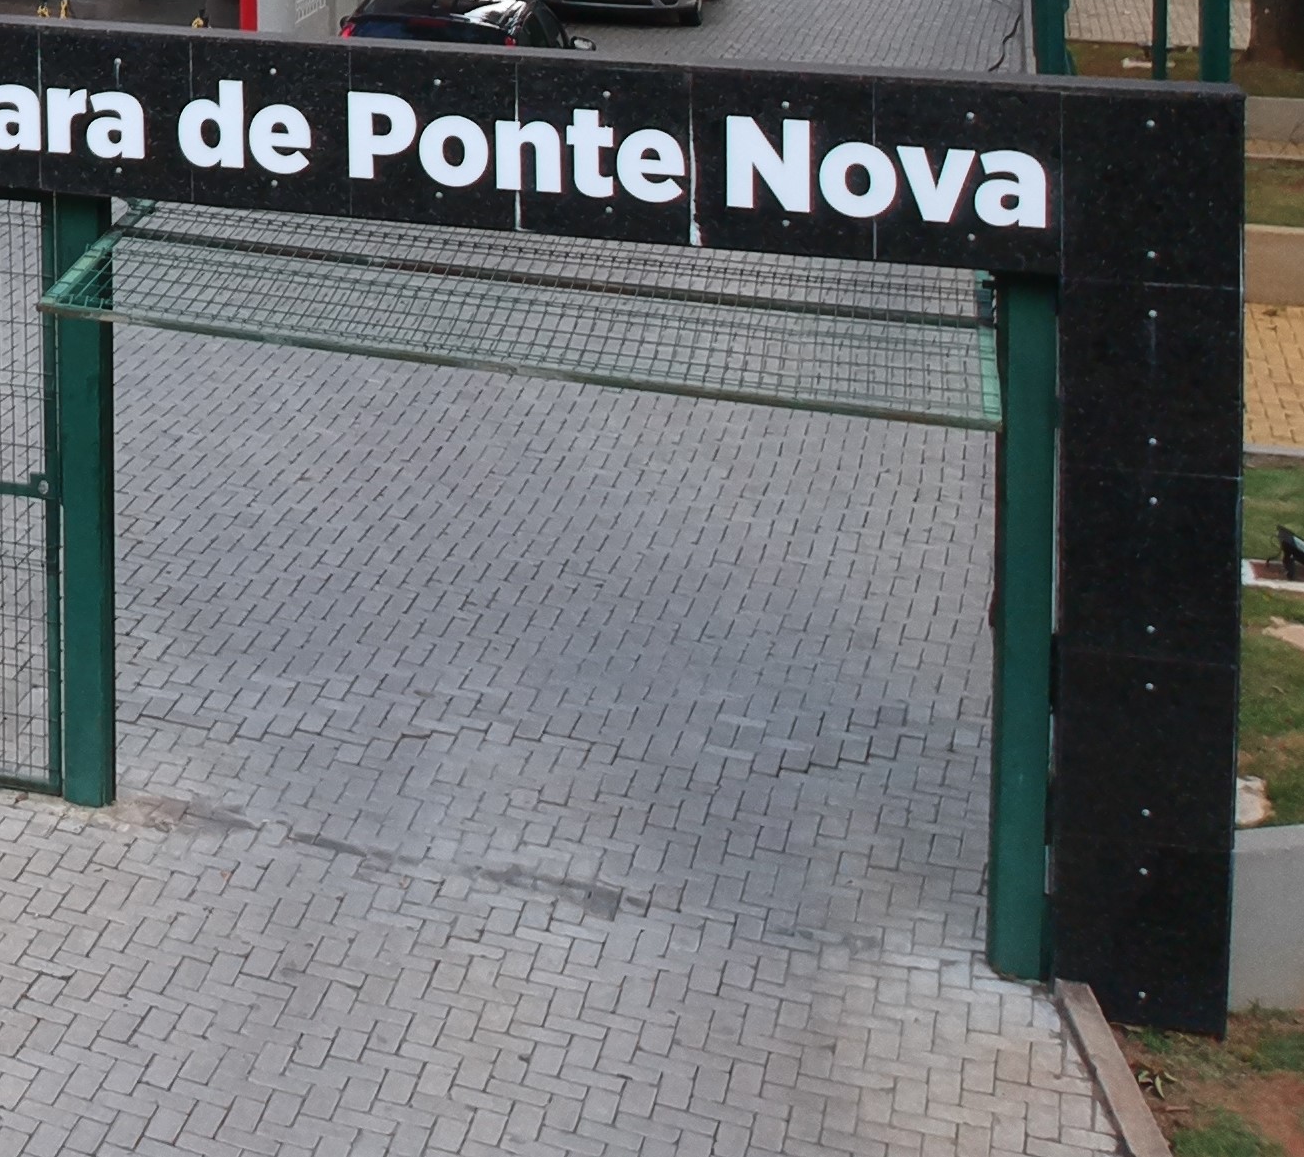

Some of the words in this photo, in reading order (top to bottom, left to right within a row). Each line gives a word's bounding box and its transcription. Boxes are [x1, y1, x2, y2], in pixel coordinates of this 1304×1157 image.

[178, 79, 312, 175] de
[347, 91, 686, 203] Ponte
[726, 115, 1047, 229] Nova
